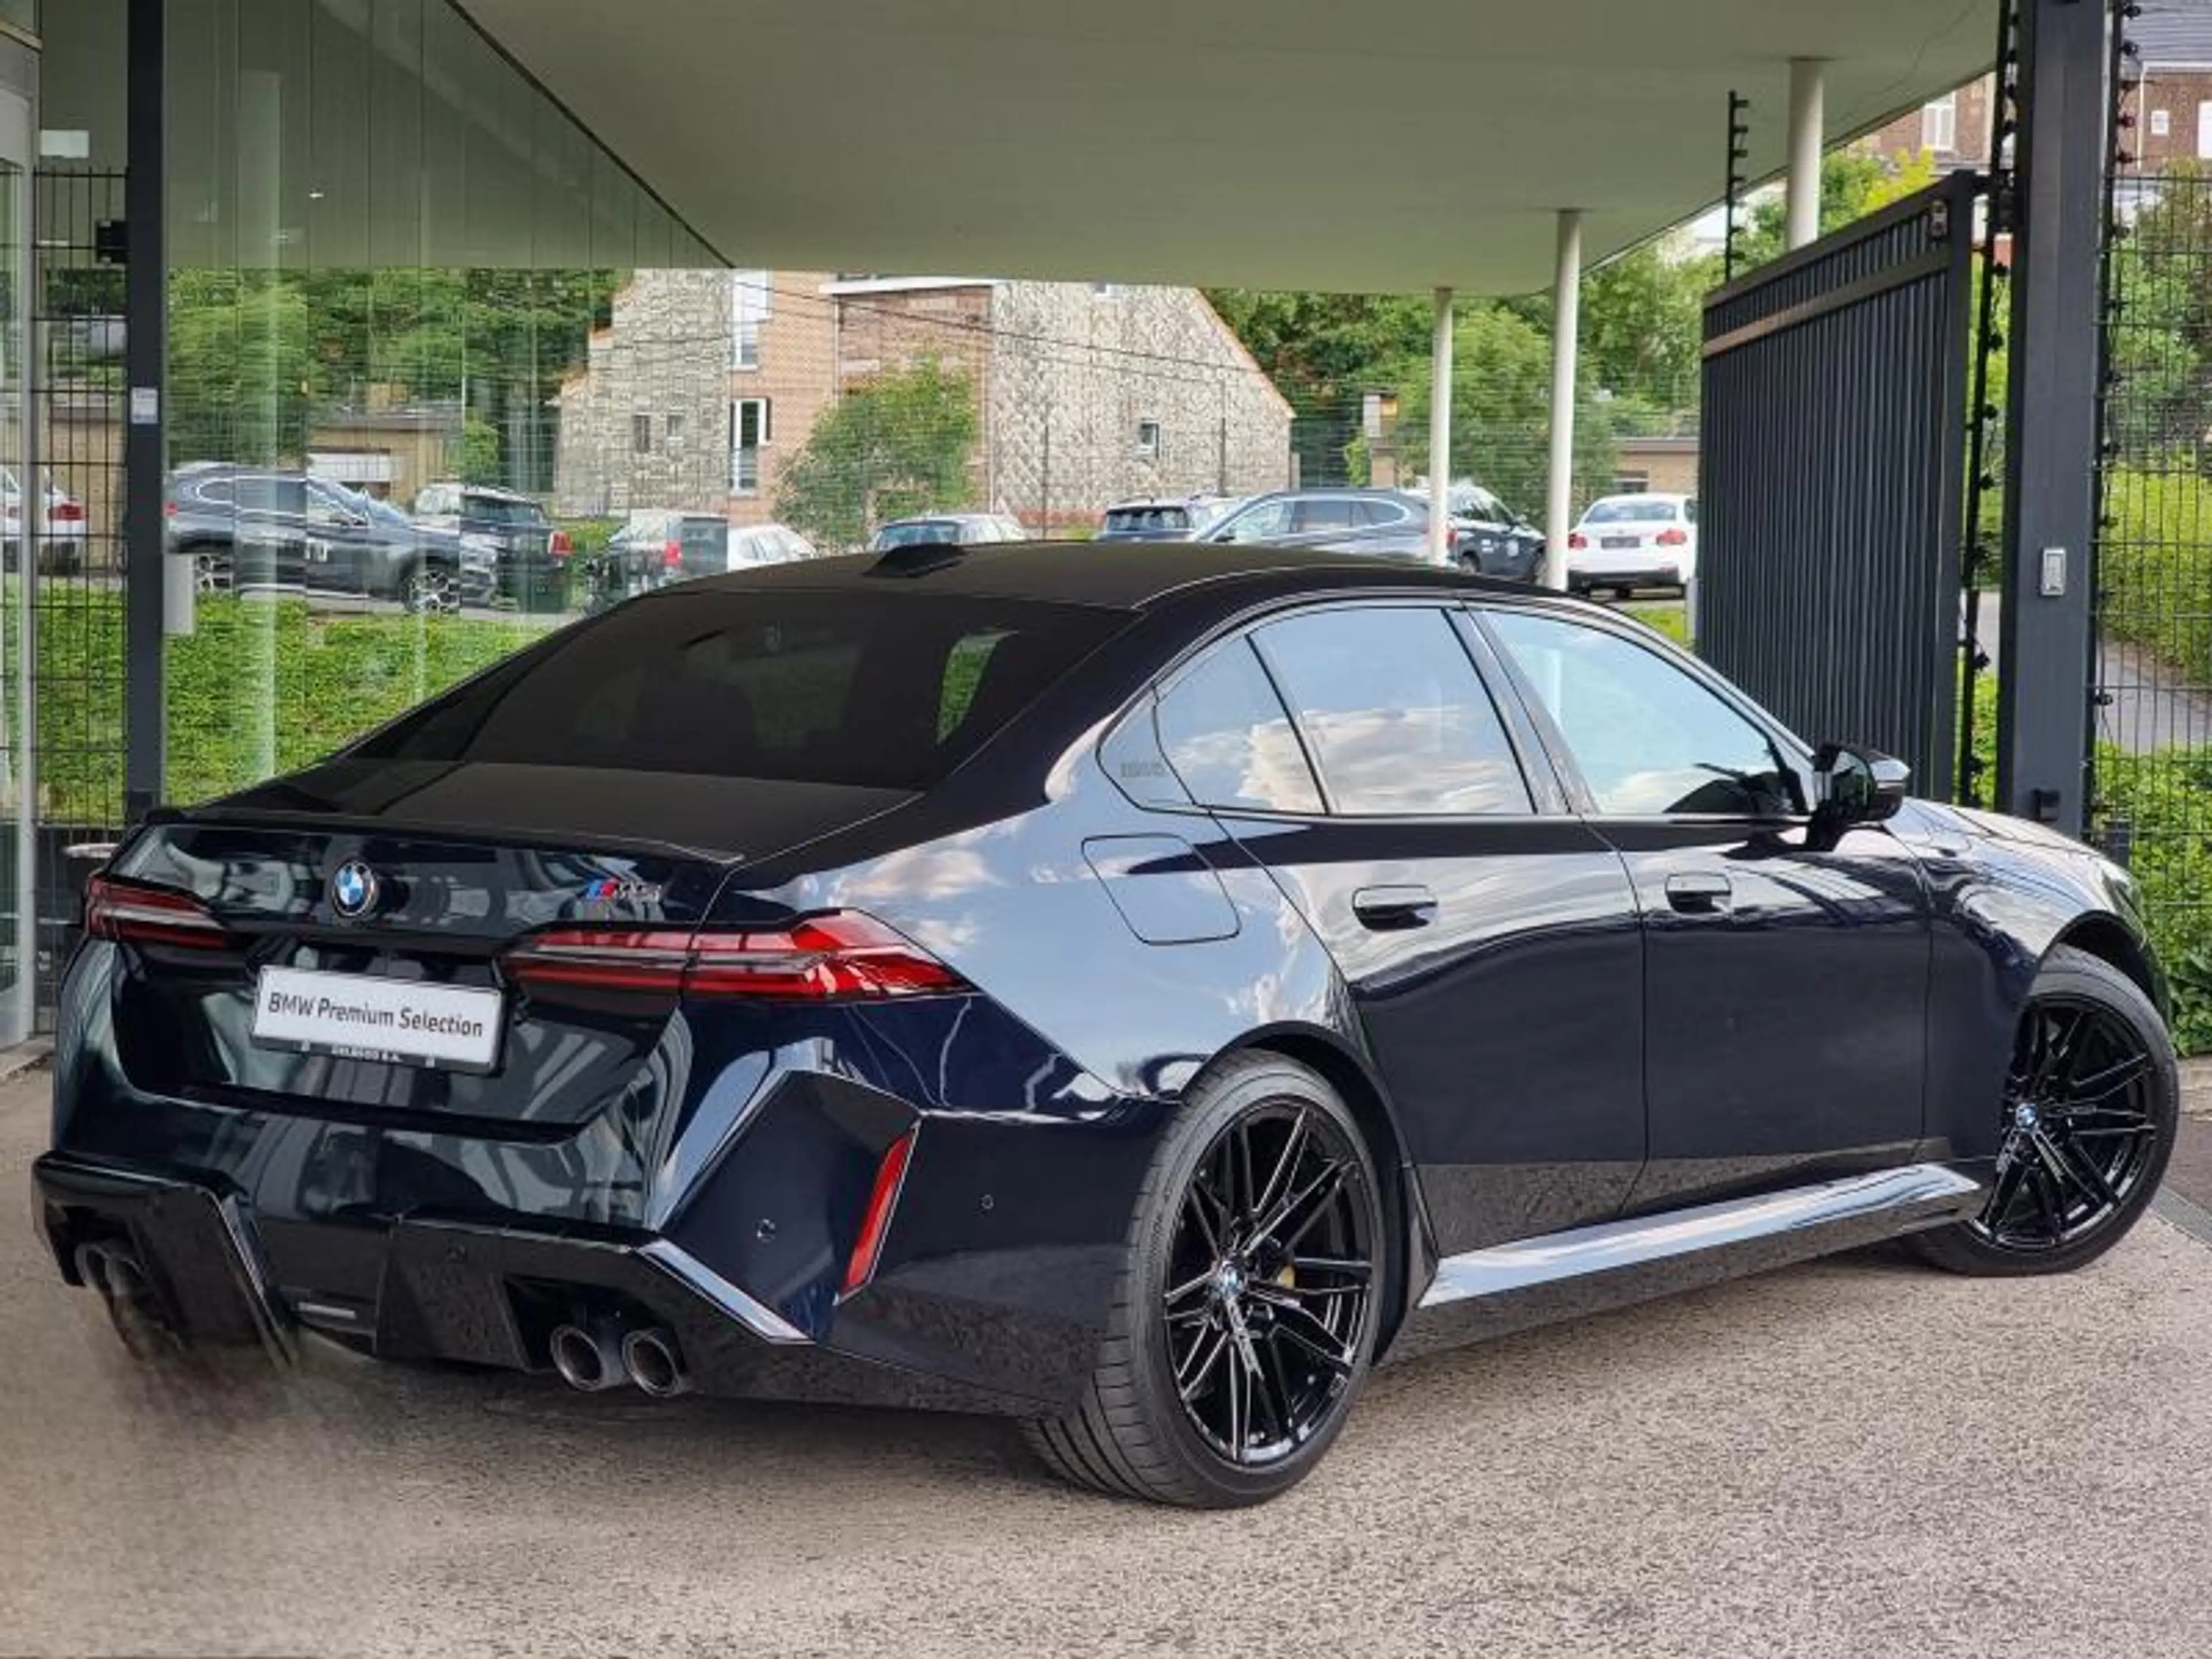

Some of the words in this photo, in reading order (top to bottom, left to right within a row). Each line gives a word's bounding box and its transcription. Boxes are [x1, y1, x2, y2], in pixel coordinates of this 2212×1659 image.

[268, 991, 314, 1017] BMW
[317, 997, 394, 1027] Premium
[398, 1006, 483, 1037] Selection
